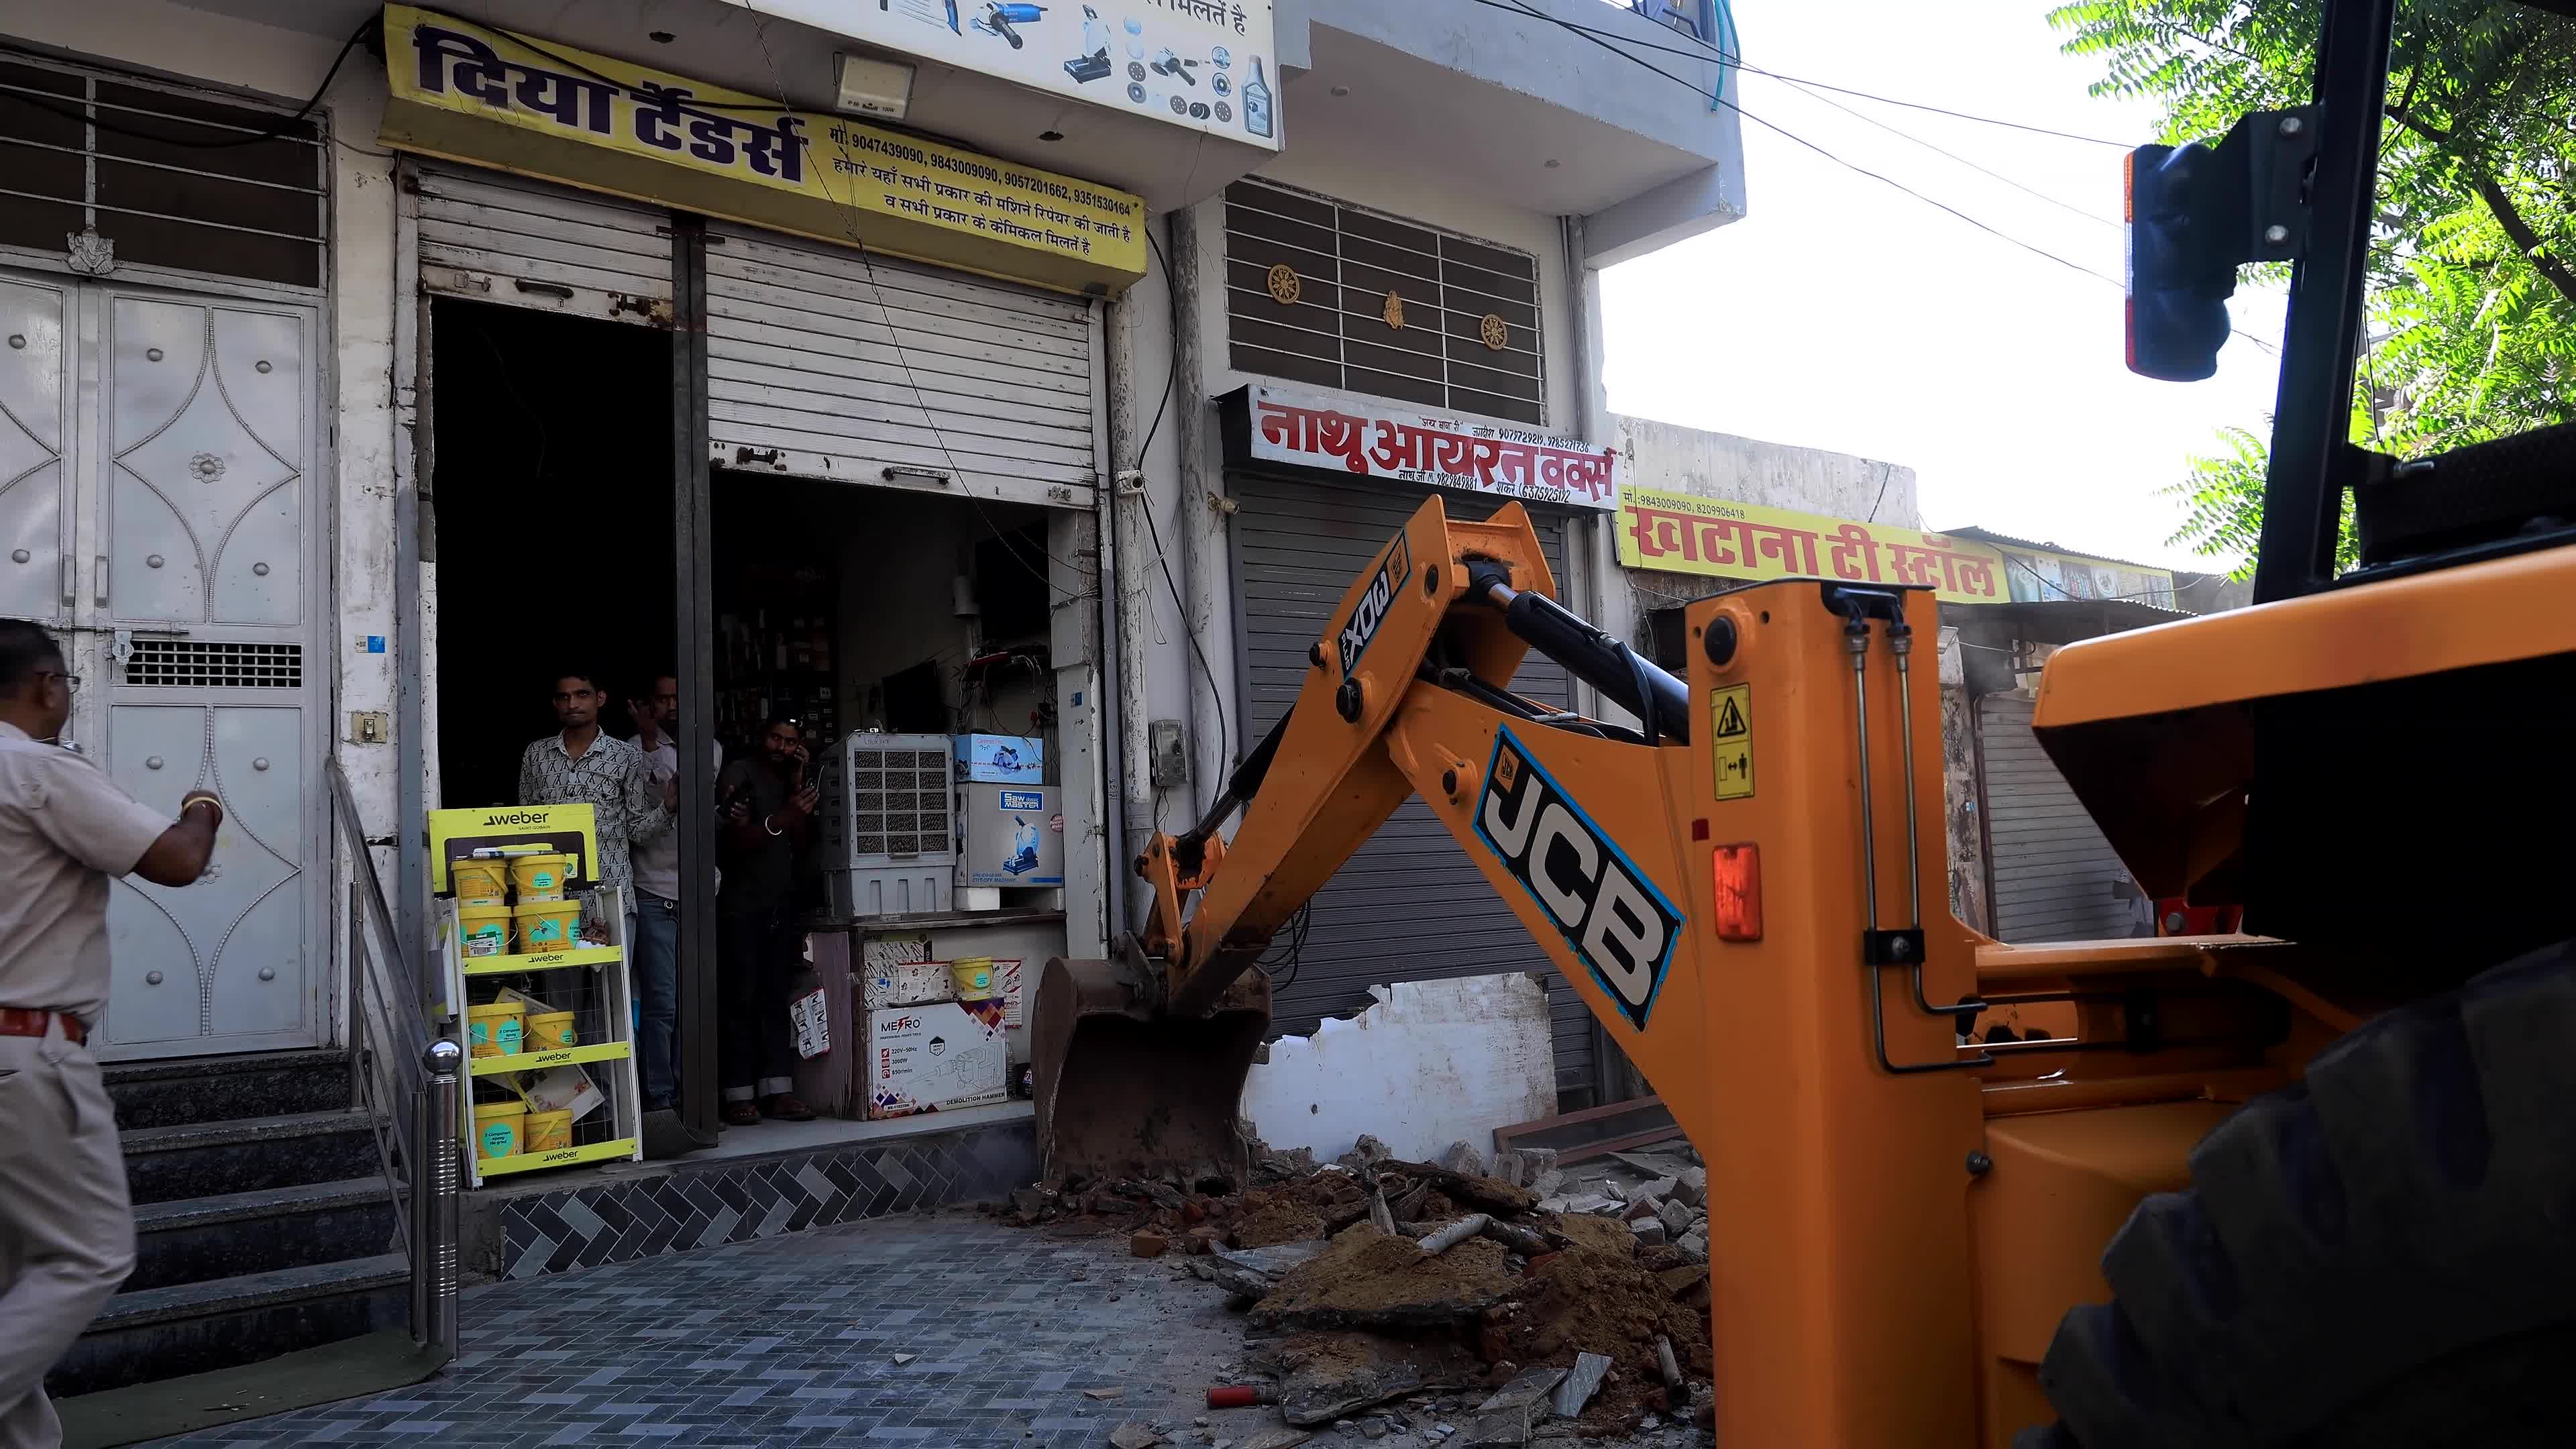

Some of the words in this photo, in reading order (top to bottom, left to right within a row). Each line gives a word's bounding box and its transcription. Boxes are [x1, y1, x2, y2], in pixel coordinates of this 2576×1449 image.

[1230, 3, 1248, 37] है
[413, 24, 619, 136] दिया
[853, 133, 928, 167] 9047439090,
[931, 154, 1002, 186] 9843009090,
[1005, 172, 1072, 203] 9057201662,
[1074, 189, 1131, 217] 9351530164
[833, 158, 868, 178] हमारे
[870, 166, 898, 185] यहाँ
[900, 175, 932, 193] सभी
[934, 182, 971, 203] प्रकार
[973, 191, 993, 208] की
[1034, 203, 1071, 227] रिपेयर
[1073, 215, 1091, 231] की
[1093, 221, 1120, 239] जाती
[1122, 225, 1132, 243] है
[883, 194, 898, 209] व
[899, 199, 930, 216] सभी
[932, 206, 969, 226] प्रकार
[971, 212, 987, 230] के
[1081, 237, 1091, 256] है
[1256, 400, 1369, 477] नाथू
[1369, 419, 1538, 488] आयरन
[1697, 504, 1746, 519] 8209906418
[1625, 505, 1820, 576] खटाना
[1825, 524, 1880, 582] टी
[1886, 535, 1996, 598] स्टॉल
[1004, 793, 1025, 802] Saw
[494, 810, 549, 825] weber
[1485, 773, 1664, 1006] JCB
[533, 953, 564, 963] weber
[542, 1053, 572, 1061] weber
[946, 1096, 981, 1106] DEMOLITION
[981, 1091, 1006, 1101] HAMMER
[547, 1150, 578, 1161] weber
